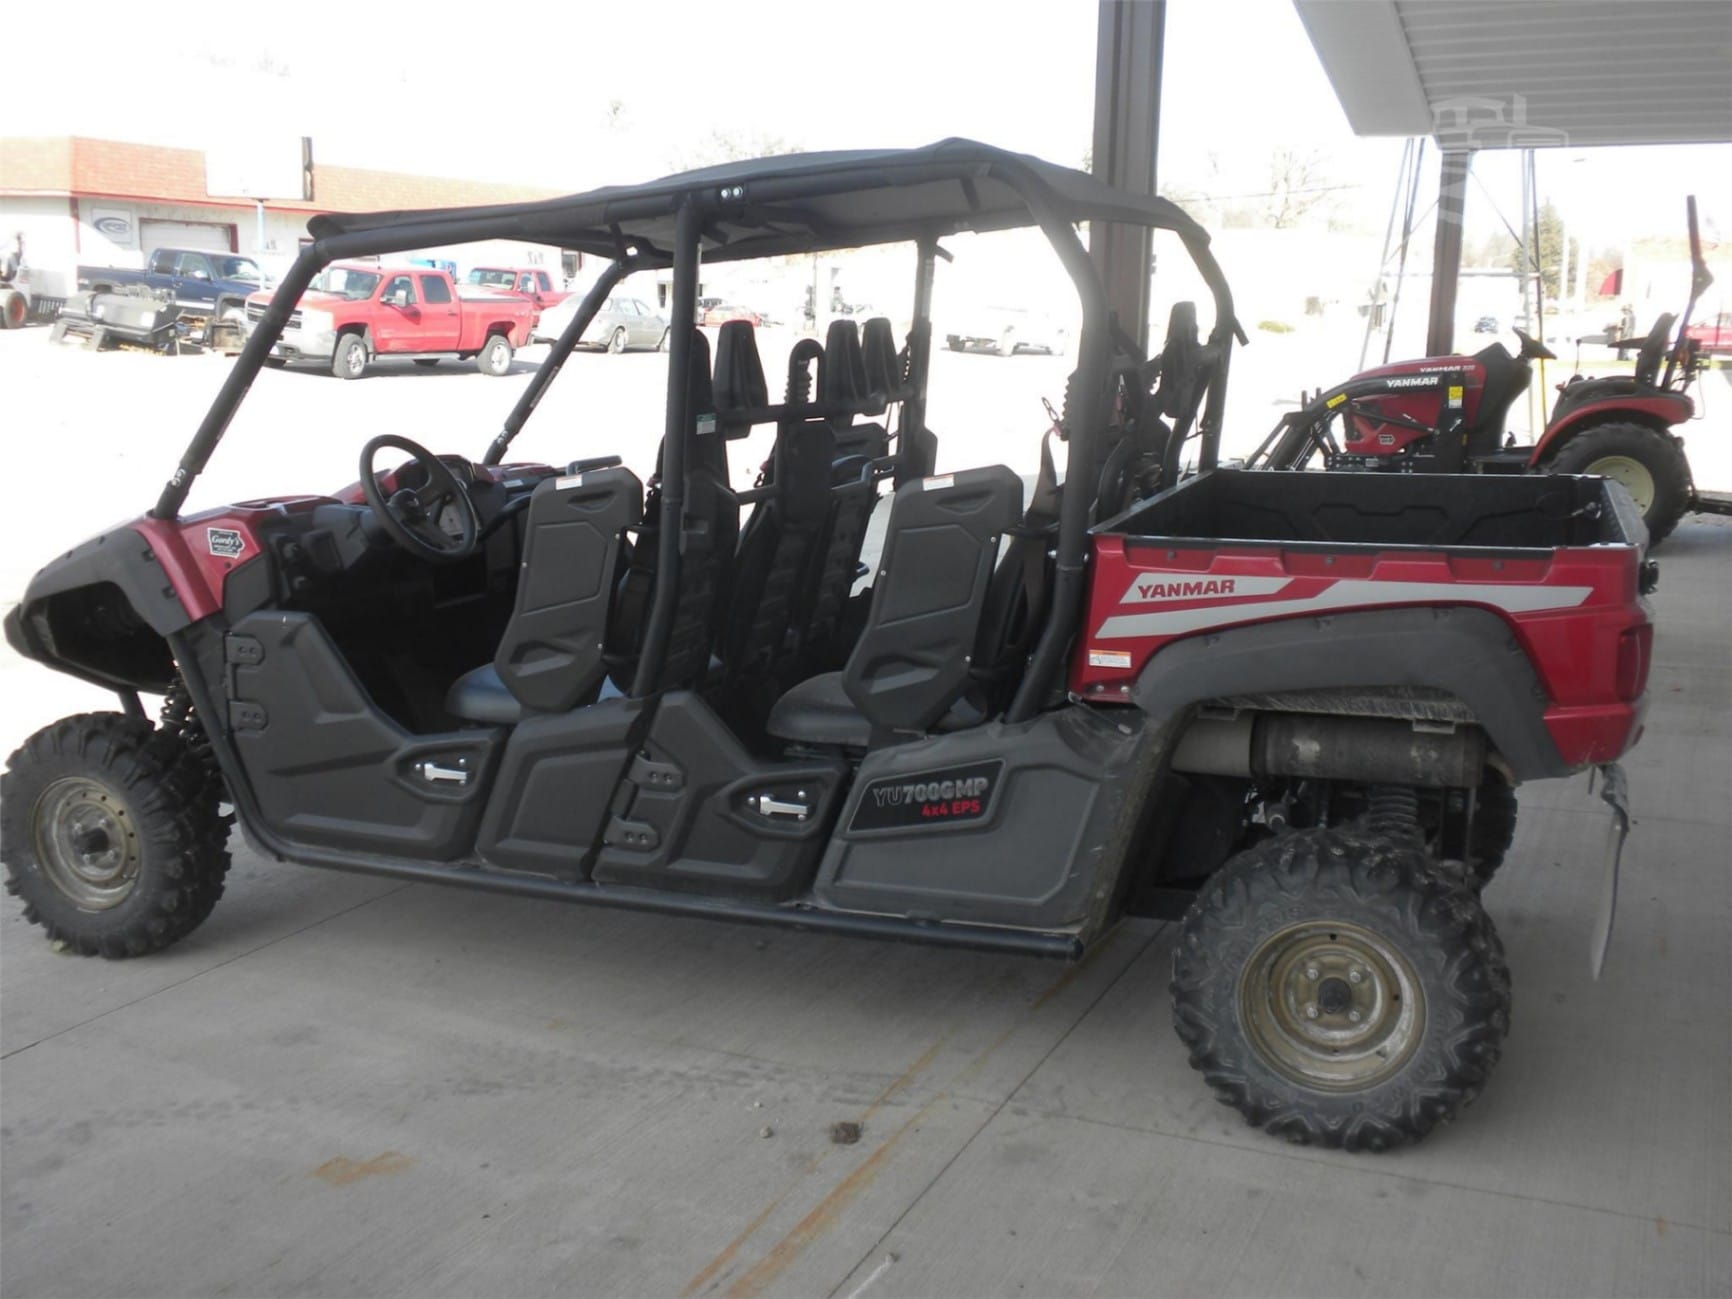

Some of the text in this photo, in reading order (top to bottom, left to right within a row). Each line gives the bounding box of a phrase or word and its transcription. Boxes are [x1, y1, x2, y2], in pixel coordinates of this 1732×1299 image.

[1386, 377, 1438, 387] YANMAR
[1138, 579, 1235, 599] YANMAR
[873, 777, 989, 808] YU700GMP
[922, 800, 981, 817] 4x4 EPS
